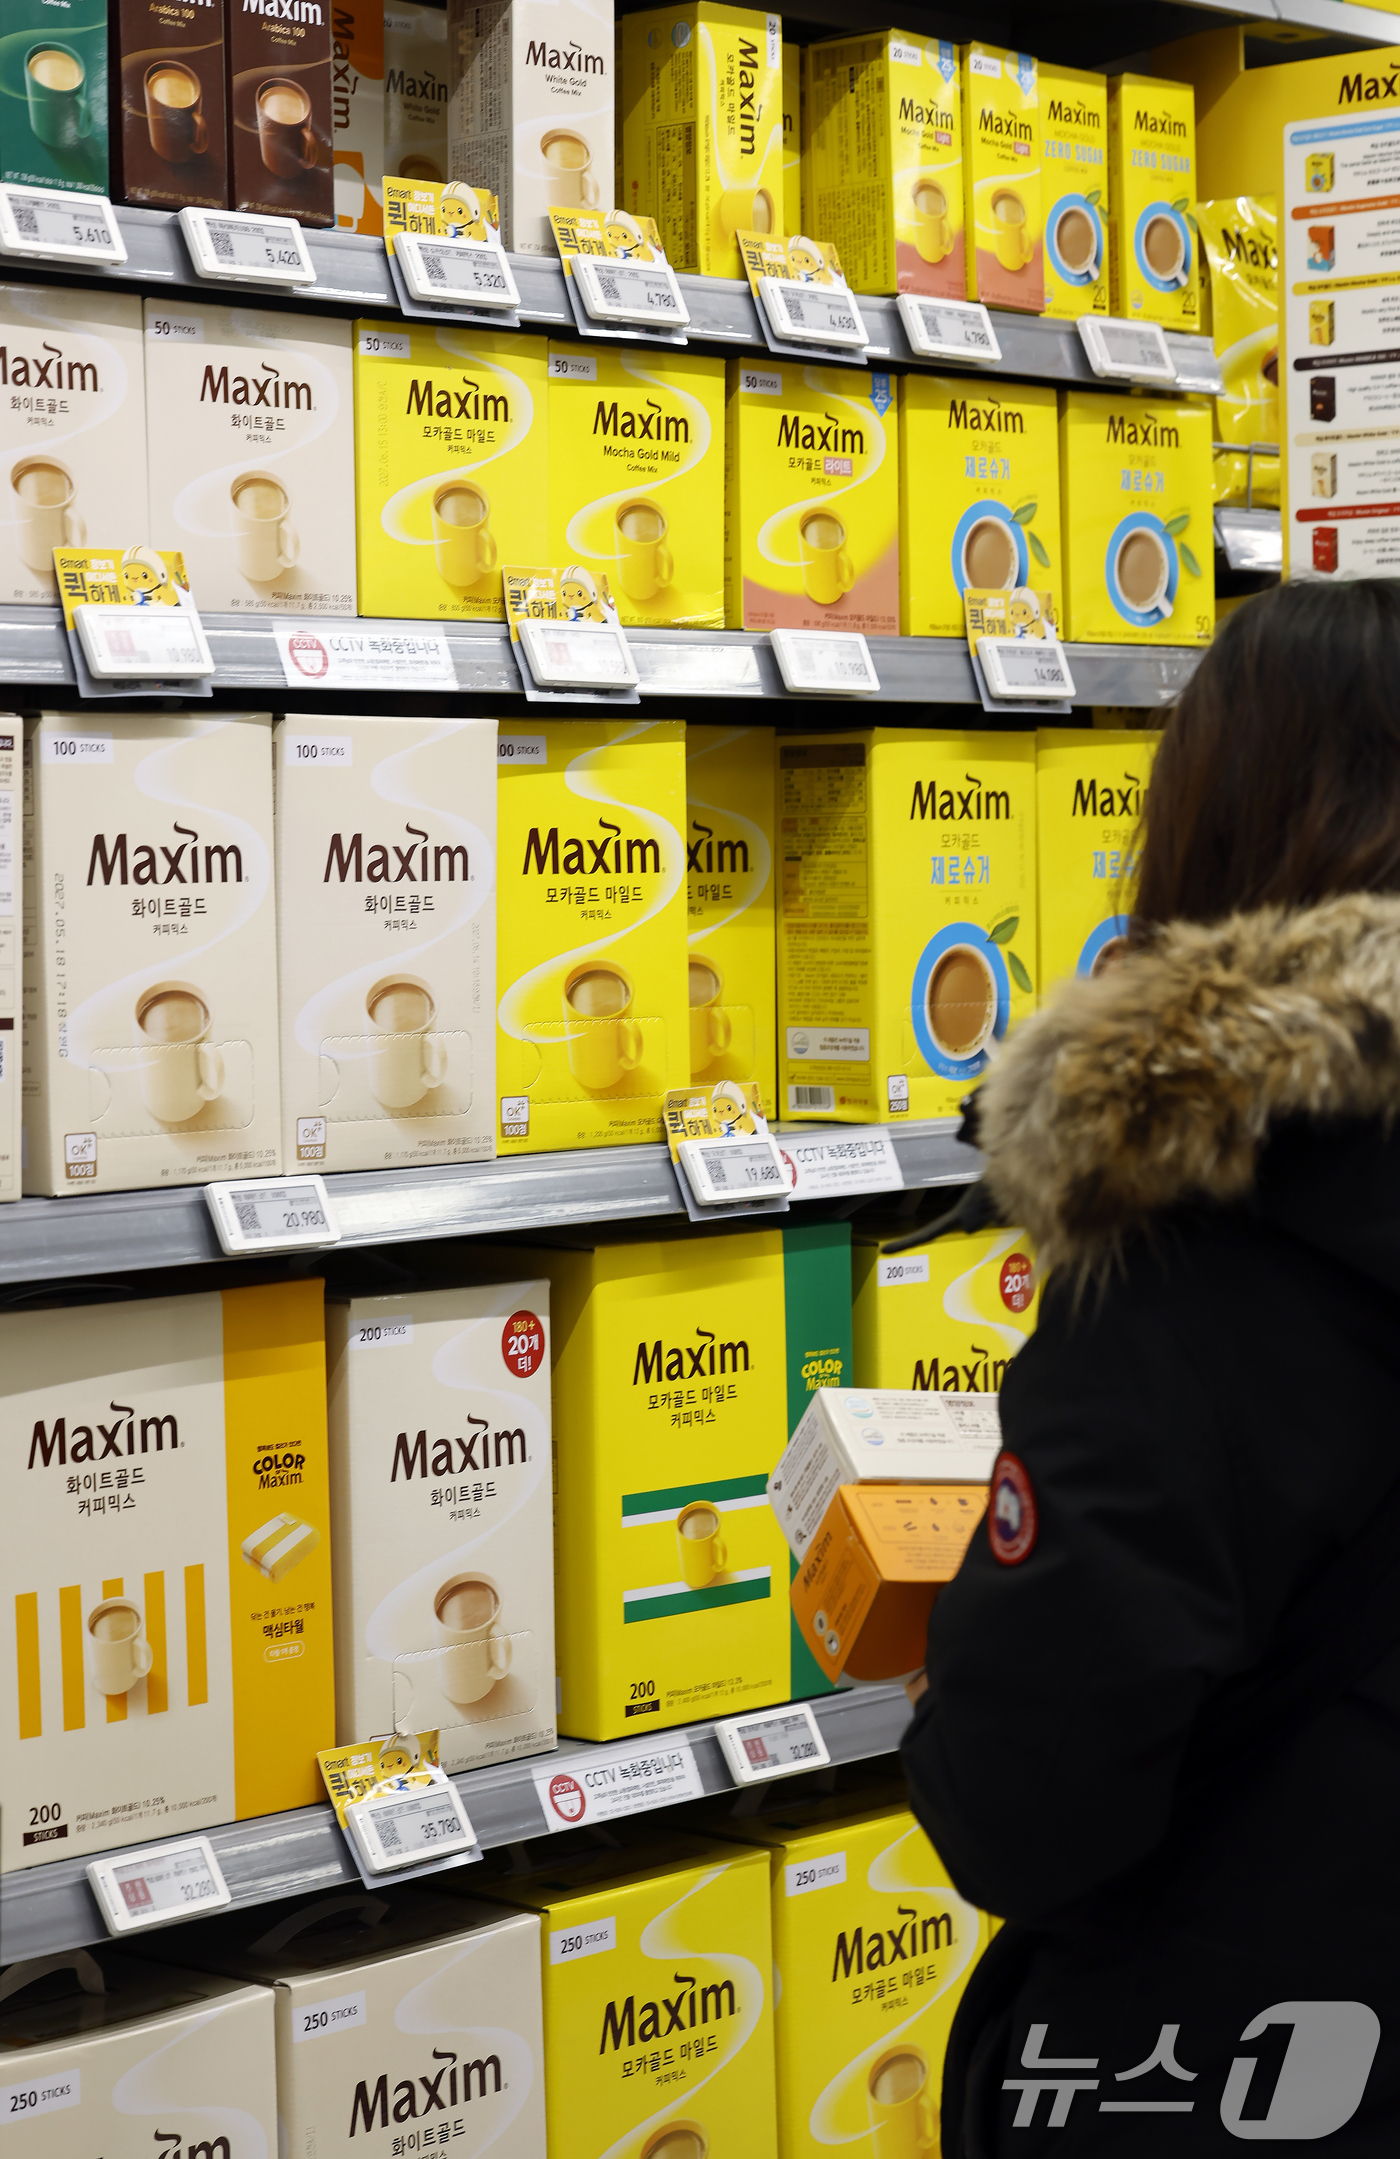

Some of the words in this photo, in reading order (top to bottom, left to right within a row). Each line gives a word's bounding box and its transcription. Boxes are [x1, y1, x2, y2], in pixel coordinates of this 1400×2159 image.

[149, 3, 179, 17] Arabica
[180, 8, 195, 20] 100
[261, 21, 291, 36] Arabica
[292, 26, 306, 38] 100
[526, 40, 604, 76] Maxim
[892, 47, 903, 60] 20
[333, 7, 359, 130] Maxim
[973, 58, 984, 71] 20
[545, 73, 566, 86] White
[567, 77, 588, 88] Gold
[550, 86, 569, 95] Coffee
[570, 88, 582, 97] Mix
[738, 37, 763, 156] Maxim
[898, 98, 955, 132] Maxim
[978, 106, 1034, 142] Maxim
[1047, 100, 1101, 130] Maxim
[1134, 110, 1188, 139] Maxim
[935, 132, 952, 146] Light
[1013, 142, 1031, 157] Light
[1044, 139, 1073, 158] ZERO
[1074, 143, 1104, 165] SUGAR
[1131, 148, 1159, 167] ZERO
[1160, 152, 1191, 173] SUGAR
[387, 186, 412, 200] emart
[388, 201, 436, 235] 퀵하게
[154, 321, 170, 336] 50
[173, 325, 196, 335] STICKS
[365, 338, 380, 351] 50
[382, 341, 404, 351] STICKS
[554, 361, 568, 374] 50
[570, 364, 591, 374] STICKS
[200, 362, 312, 411] Maxim
[745, 375, 757, 389] 50
[758, 378, 778, 390] STICKS
[10, 396, 70, 414] 화이트골드
[406, 375, 509, 424] Maxim
[230, 413, 286, 432] 화이트골드
[593, 398, 689, 443] Maxim
[948, 396, 1024, 434] Maxim
[245, 434, 272, 444] 커피믹스
[422, 425, 464, 442] 모카골드
[467, 428, 496, 443] 마일드
[777, 411, 865, 455] Maxim
[1106, 413, 1180, 448] Maxim
[446, 444, 472, 455] 커피믹스
[602, 444, 636, 460] Mocha
[637, 447, 659, 461] Gold
[660, 450, 681, 463] Mild
[972, 439, 1002, 454] 모카골드
[626, 464, 646, 474] Coffee
[646, 465, 659, 474] Mix
[787, 455, 823, 472] 모카골드
[824, 458, 852, 475] 라이트
[964, 456, 1011, 481] 제로슈거
[810, 476, 832, 487] 커피믹스
[1120, 469, 1165, 493] 제로슈거
[60, 557, 89, 569] emart
[64, 572, 121, 603] 퀵하게
[292, 637, 318, 650] CCTV
[329, 637, 365, 653] CCTV
[367, 638, 442, 656] 녹화중입니다
[53, 741, 77, 755] 100
[80, 743, 106, 753] STICKS
[296, 744, 318, 758] 100
[321, 747, 345, 757] STICKS
[517, 746, 540, 755] STICKS
[910, 772, 1010, 821] Maxim
[522, 816, 660, 875] Maxim
[940, 833, 981, 849] 모카골드
[87, 821, 243, 886] Maxim
[323, 822, 469, 883] Maxim
[930, 855, 990, 885] 제로슈거
[545, 886, 600, 905] 모카골드
[606, 885, 643, 904] 마일드
[698, 884, 733, 901] 마일드
[131, 897, 208, 919] 화이트골드
[364, 895, 435, 915] 화이트골드
[580, 909, 612, 921] 커피믹스
[152, 923, 189, 937] 커피믹스
[383, 919, 418, 931] 커피믹스
[668, 1110, 713, 1137] 퀵하게
[796, 1148, 826, 1163] CCTV
[827, 1140, 885, 1160] 녹화중입니다
[69, 1163, 95, 1178] 100점
[886, 1266, 904, 1279] 200
[905, 1265, 924, 1275] STICKS
[1008, 1261, 1028, 1273] 180+
[359, 1326, 382, 1342] 200
[383, 1326, 406, 1337] STICKS
[512, 1319, 535, 1334] 180+
[508, 1333, 539, 1356] 20개
[517, 1356, 532, 1373] 더!
[633, 1326, 750, 1386] Maxim
[801, 1358, 843, 1379] COLOR
[647, 1388, 698, 1411] 모카골드
[702, 1384, 738, 1405] 마일드
[670, 1409, 716, 1429] 커피믹스
[27, 1400, 178, 1470] Maxim
[390, 1413, 527, 1483] Maxim
[252, 1453, 306, 1476] COLOR
[66, 1466, 146, 1495] 화이트골드
[258, 1470, 304, 1490] Maxim
[78, 1493, 136, 1517] 커피믹스
[430, 1481, 497, 1508] 화이트골드
[449, 1506, 481, 1522] 커피믹스
[803, 1531, 833, 1593] Maxim
[263, 1618, 304, 1639] 맥심타월
[630, 1679, 656, 1700] 200
[584, 1768, 617, 1788] CCTV
[618, 1751, 684, 1780] 녹화중입니다
[552, 1780, 576, 1794] CCTV
[29, 1803, 61, 1826] 200
[33, 1828, 58, 1843] STICKS
[795, 1868, 816, 1888] 250
[818, 1863, 840, 1880] STICKS
[560, 1934, 583, 1955] 250
[584, 1929, 609, 1946] STICKS
[832, 1904, 953, 1982] Maxim
[851, 1975, 899, 2005] 모카골드
[902, 1964, 937, 1988] 마일드
[599, 1971, 735, 2055] Maxim
[881, 1996, 909, 2013] 커피믹스
[303, 2011, 328, 2032] 250
[331, 2004, 358, 2022] STICKS
[621, 2046, 676, 2080] 모카골드
[680, 2034, 718, 2062] 마일드
[655, 2069, 687, 2087] 커피믹스
[10, 2090, 38, 2113] 250
[41, 2084, 71, 2102] STICKS
[348, 2046, 501, 2139] Maxim
[391, 2117, 466, 2157] 화이트골드
